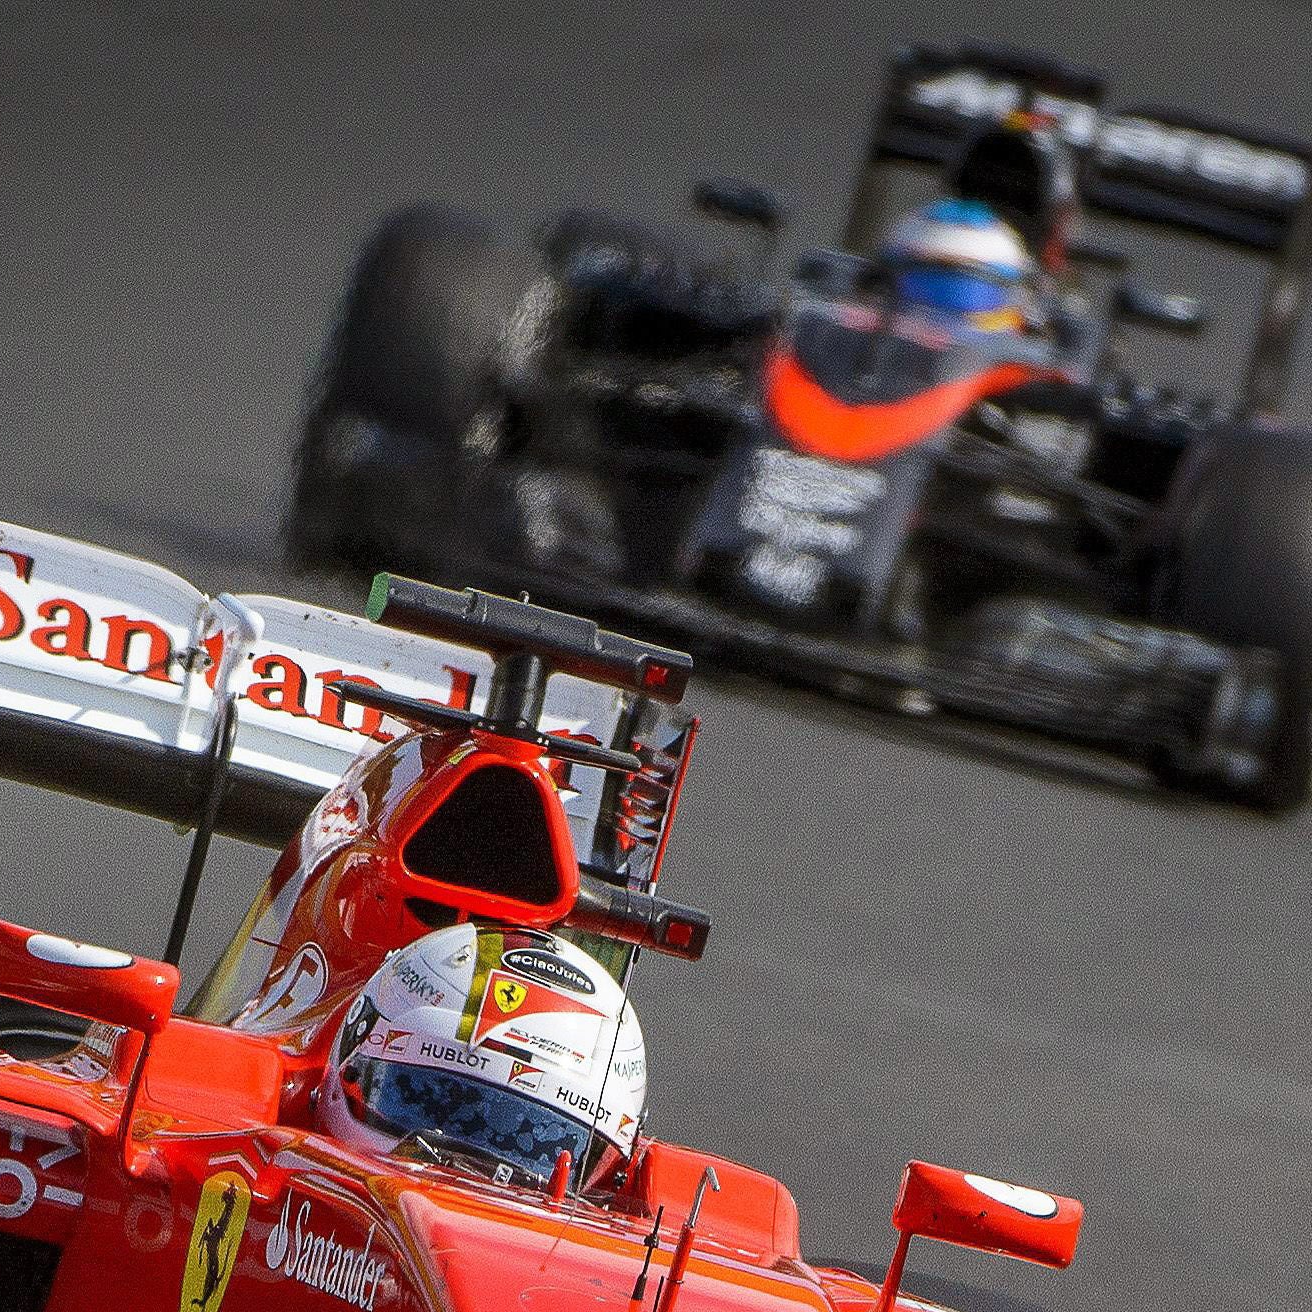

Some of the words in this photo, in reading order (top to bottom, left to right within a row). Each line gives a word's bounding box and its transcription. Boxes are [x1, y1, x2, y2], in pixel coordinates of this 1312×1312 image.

[508, 952, 593, 994] #CiaoJules
[419, 1041, 491, 1071] HUBLOT
[556, 1086, 612, 1124] HUBLOT
[284, 1200, 386, 1312] Santander
